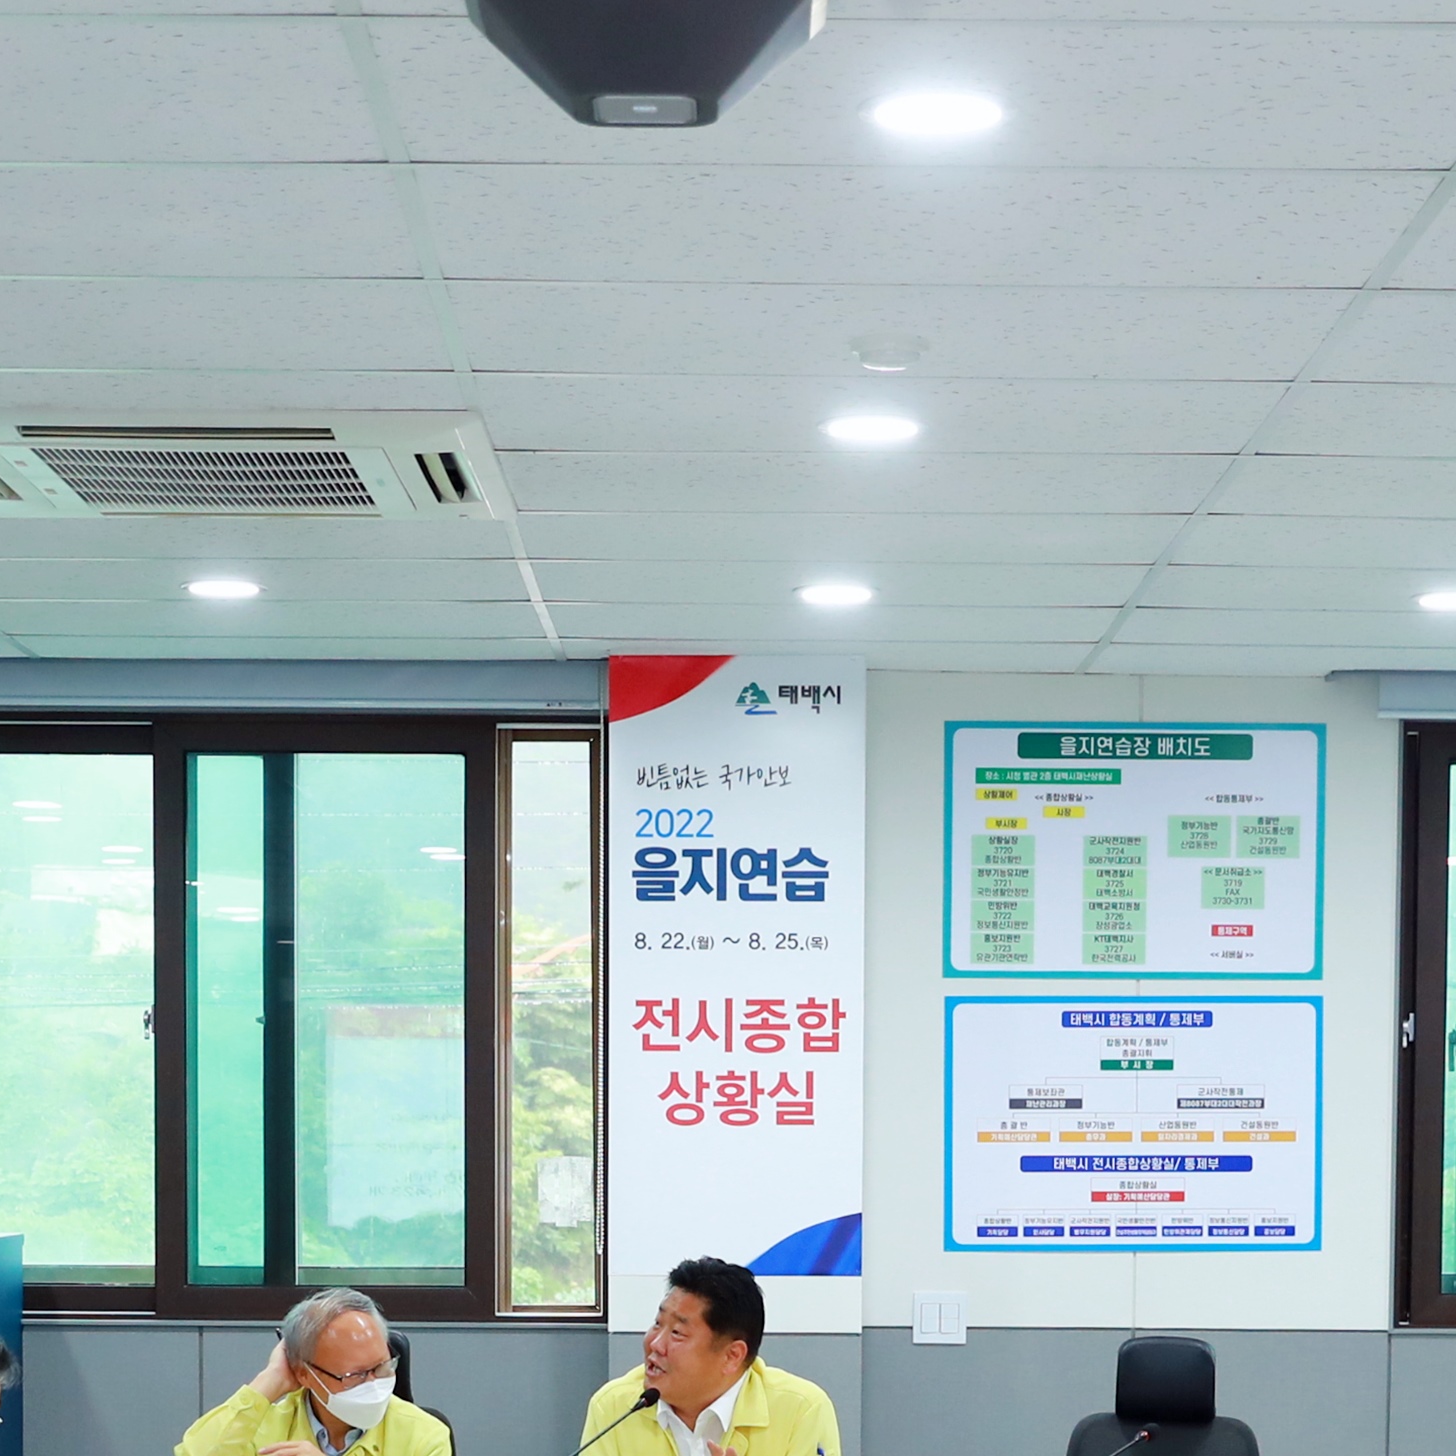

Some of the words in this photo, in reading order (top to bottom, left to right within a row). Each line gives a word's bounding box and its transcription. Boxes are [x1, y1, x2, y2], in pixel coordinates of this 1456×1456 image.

[778, 684, 841, 714] 태백시
[1059, 736, 1151, 756] 을지연습장
[1157, 737, 1211, 757] 배치도
[636, 764, 710, 790] 빈틈없는
[718, 764, 793, 789] 국가안보
[985, 771, 1000, 781] 장소
[1045, 793, 1083, 802] 종합상황실
[1216, 794, 1253, 804] 합동통제부
[1056, 807, 1072, 817] 시장
[635, 809, 714, 838] 2022
[995, 819, 1018, 829] 부시장
[1257, 816, 1280, 825] 총괄반
[1181, 821, 1218, 830] 정부기능반
[988, 836, 1018, 845] 상황실장
[1089, 836, 1142, 846] 군사작전지원반
[1258, 837, 1278, 845] 3729
[1180, 841, 1218, 850] 산업동원반
[993, 846, 1013, 855] 3720
[1105, 847, 1124, 855] 3724
[1249, 846, 1287, 855] 건설동원반
[984, 855, 1022, 864] 종합상황반
[631, 846, 830, 903] 을지연습
[977, 868, 1029, 878] 정부기능유지반
[1096, 869, 1133, 878] 태백경찰서
[1215, 867, 1252, 876] 문서취급소
[993, 879, 1012, 887] 3721
[1105, 880, 1124, 888] 3725
[1224, 879, 1242, 887] 3719
[1096, 888, 1133, 897] 태백소방서
[1225, 888, 1240, 896] FAX
[987, 901, 1018, 910] 민방위반
[1212, 897, 1253, 905] 3730-3731
[1088, 902, 1140, 911] 태백교육지원청
[993, 912, 1012, 920] 3722
[976, 920, 1028, 930] 정보통신지원반
[1217, 926, 1248, 935] 통제구역
[984, 934, 1021, 943] 홍보지원반
[1093, 934, 1134, 944] KT태백지사
[993, 945, 1012, 953] 3723
[1104, 945, 1123, 953] 3727
[1091, 953, 1136, 963] 한국전력공사
[1221, 950, 1243, 959] 서버실
[1070, 1013, 1105, 1026] 태백시
[1109, 1013, 1156, 1026] 합동계획
[1169, 1013, 1205, 1026] 통제부
[632, 997, 847, 1053] 전시종합
[1106, 1038, 1137, 1047] 합동계획
[1145, 1038, 1168, 1047] 통제부
[1197, 1087, 1244, 1096] 군사작전통제
[657, 1070, 816, 1126] 상황실
[1053, 1157, 1088, 1171] 태백시
[1184, 1157, 1219, 1170] 통제부
[1119, 1181, 1157, 1190] 종합상황실
